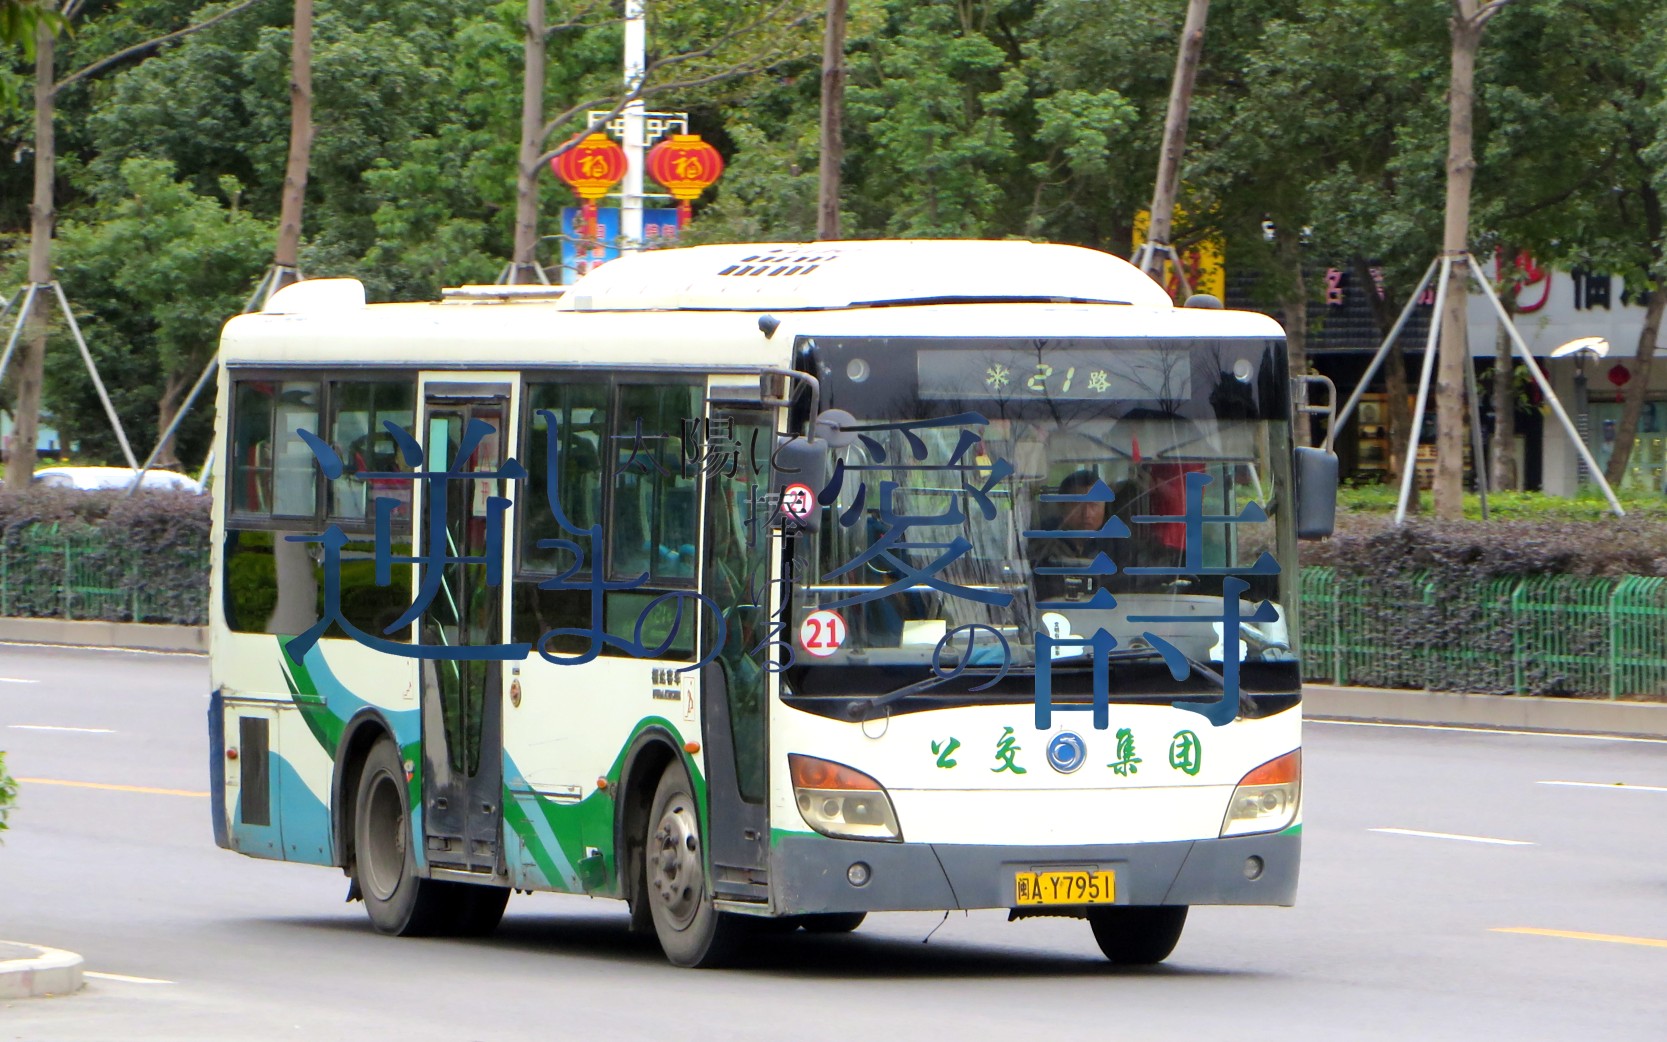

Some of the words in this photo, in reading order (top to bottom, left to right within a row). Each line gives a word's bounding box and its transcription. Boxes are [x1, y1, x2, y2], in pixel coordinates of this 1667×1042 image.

[578, 150, 608, 177] 福
[672, 151, 703, 178] 福
[806, 618, 840, 648] 21
